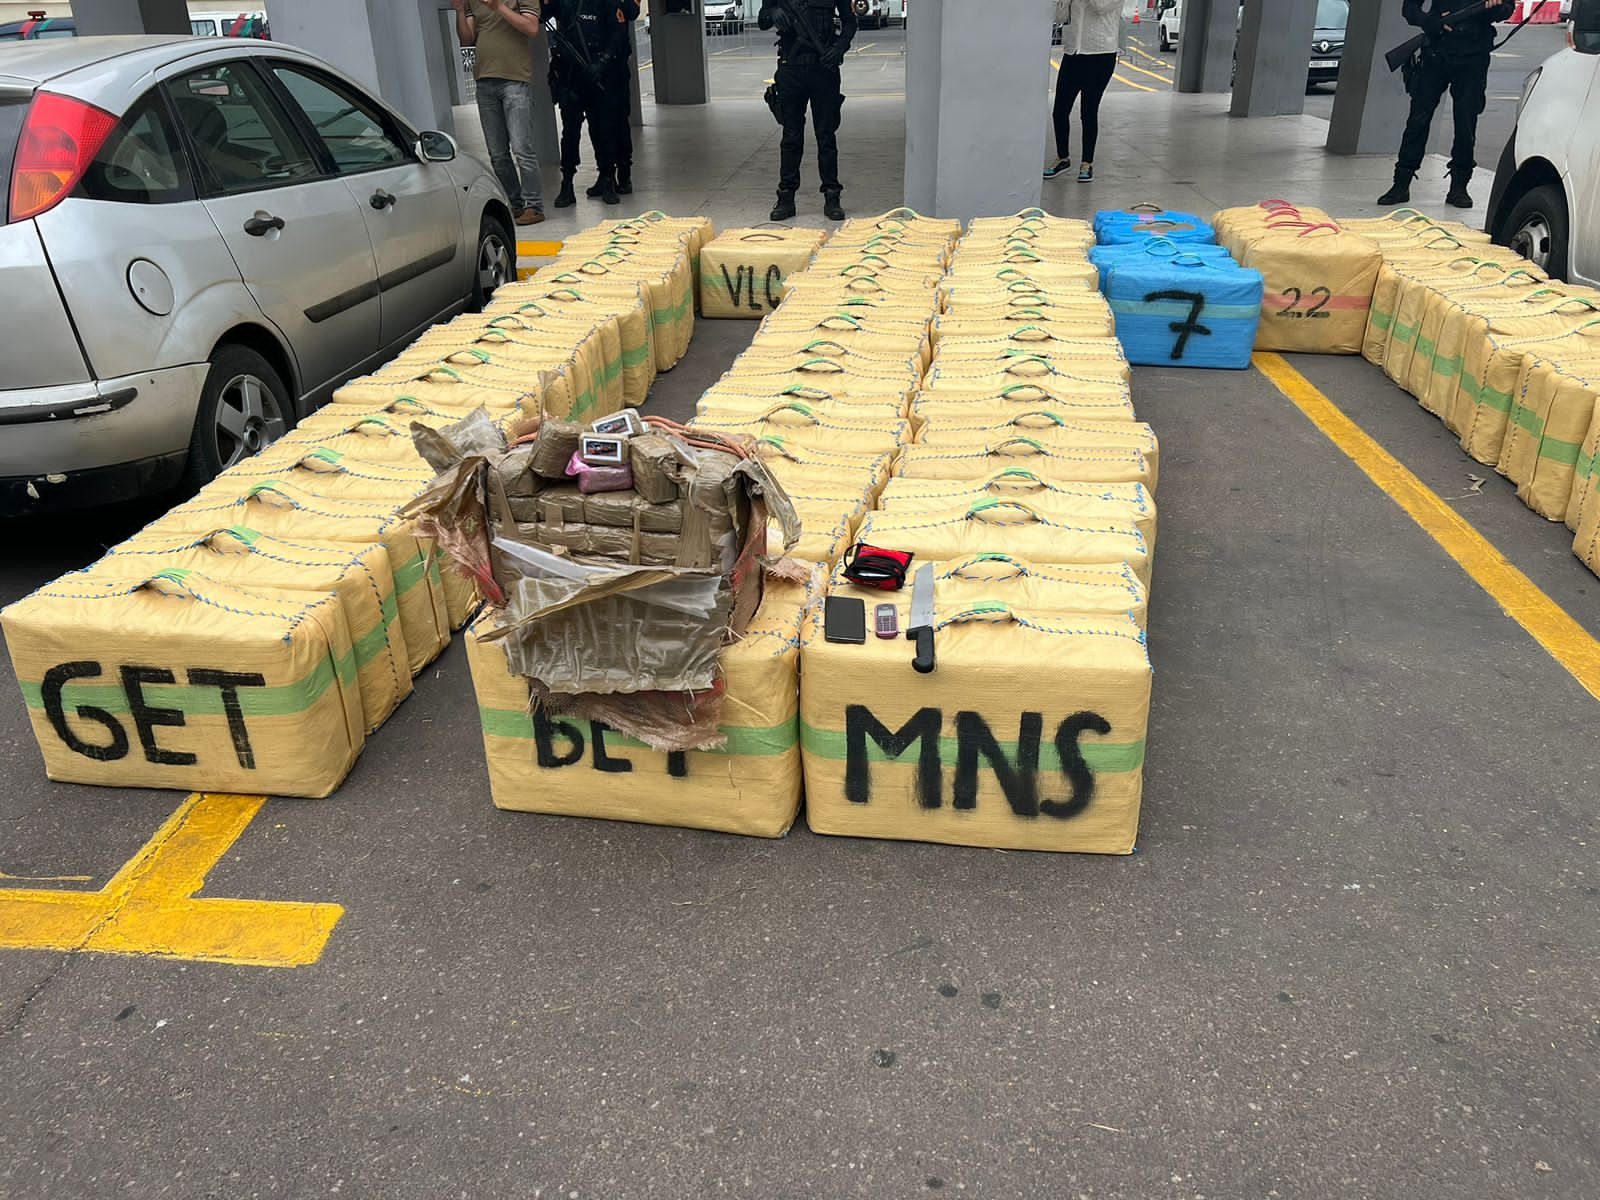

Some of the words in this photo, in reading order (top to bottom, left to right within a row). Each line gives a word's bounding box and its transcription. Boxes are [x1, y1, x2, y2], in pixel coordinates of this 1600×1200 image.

[720, 263, 781, 310] VLC
[1276, 286, 1331, 318] 22
[1143, 289, 1211, 360] 7
[41, 660, 266, 770] GET
[844, 703, 1112, 820] MNS
